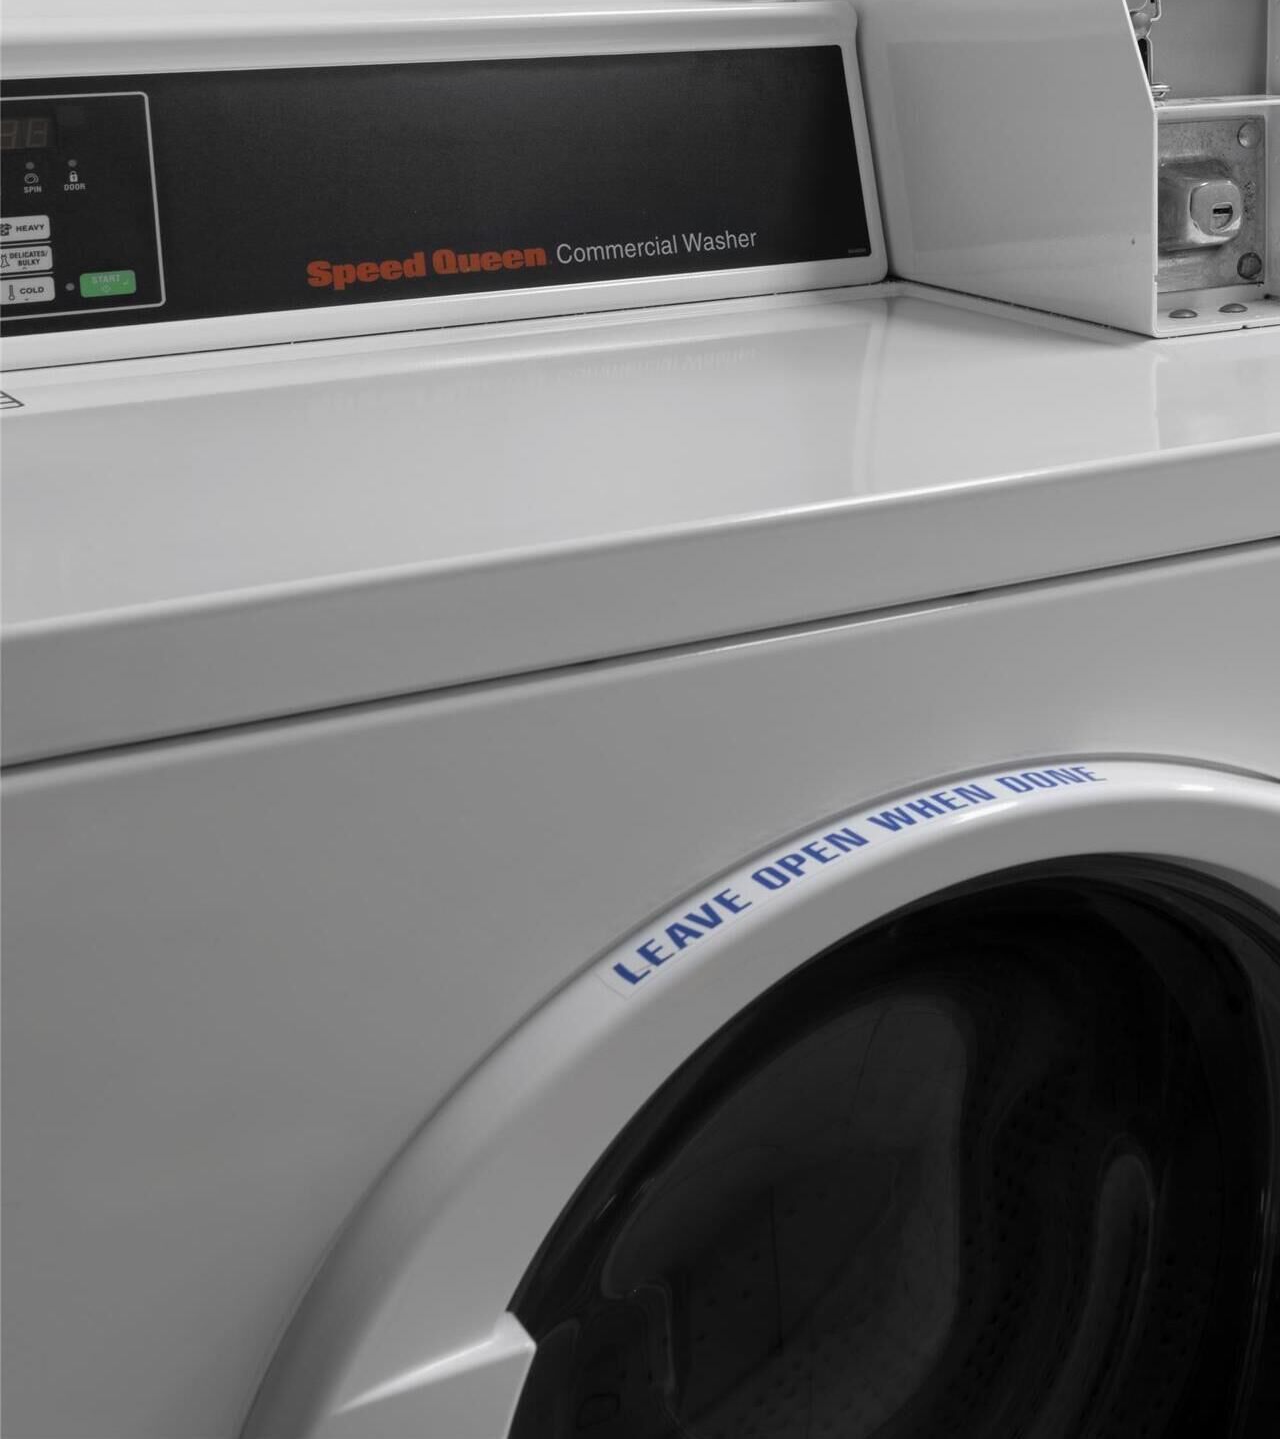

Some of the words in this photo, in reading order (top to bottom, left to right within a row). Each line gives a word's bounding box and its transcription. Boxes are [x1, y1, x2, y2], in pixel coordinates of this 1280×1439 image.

[23, 185, 42, 194] SPIN
[63, 183, 86, 192] DOOR
[15, 223, 45, 233] HEAVY
[9, 250, 48, 260] DELICATES/
[17, 258, 41, 267] BULKY
[306, 251, 427, 290] Speed
[432, 246, 547, 275] Queen
[556, 234, 677, 264] Commercial
[682, 230, 757, 253] Washer
[19, 286, 45, 295] COLD
[612, 887, 752, 986] LEAVE
[750, 826, 870, 891] OPEN
[866, 782, 998, 832] WHEN
[993, 765, 1108, 794] DONE
